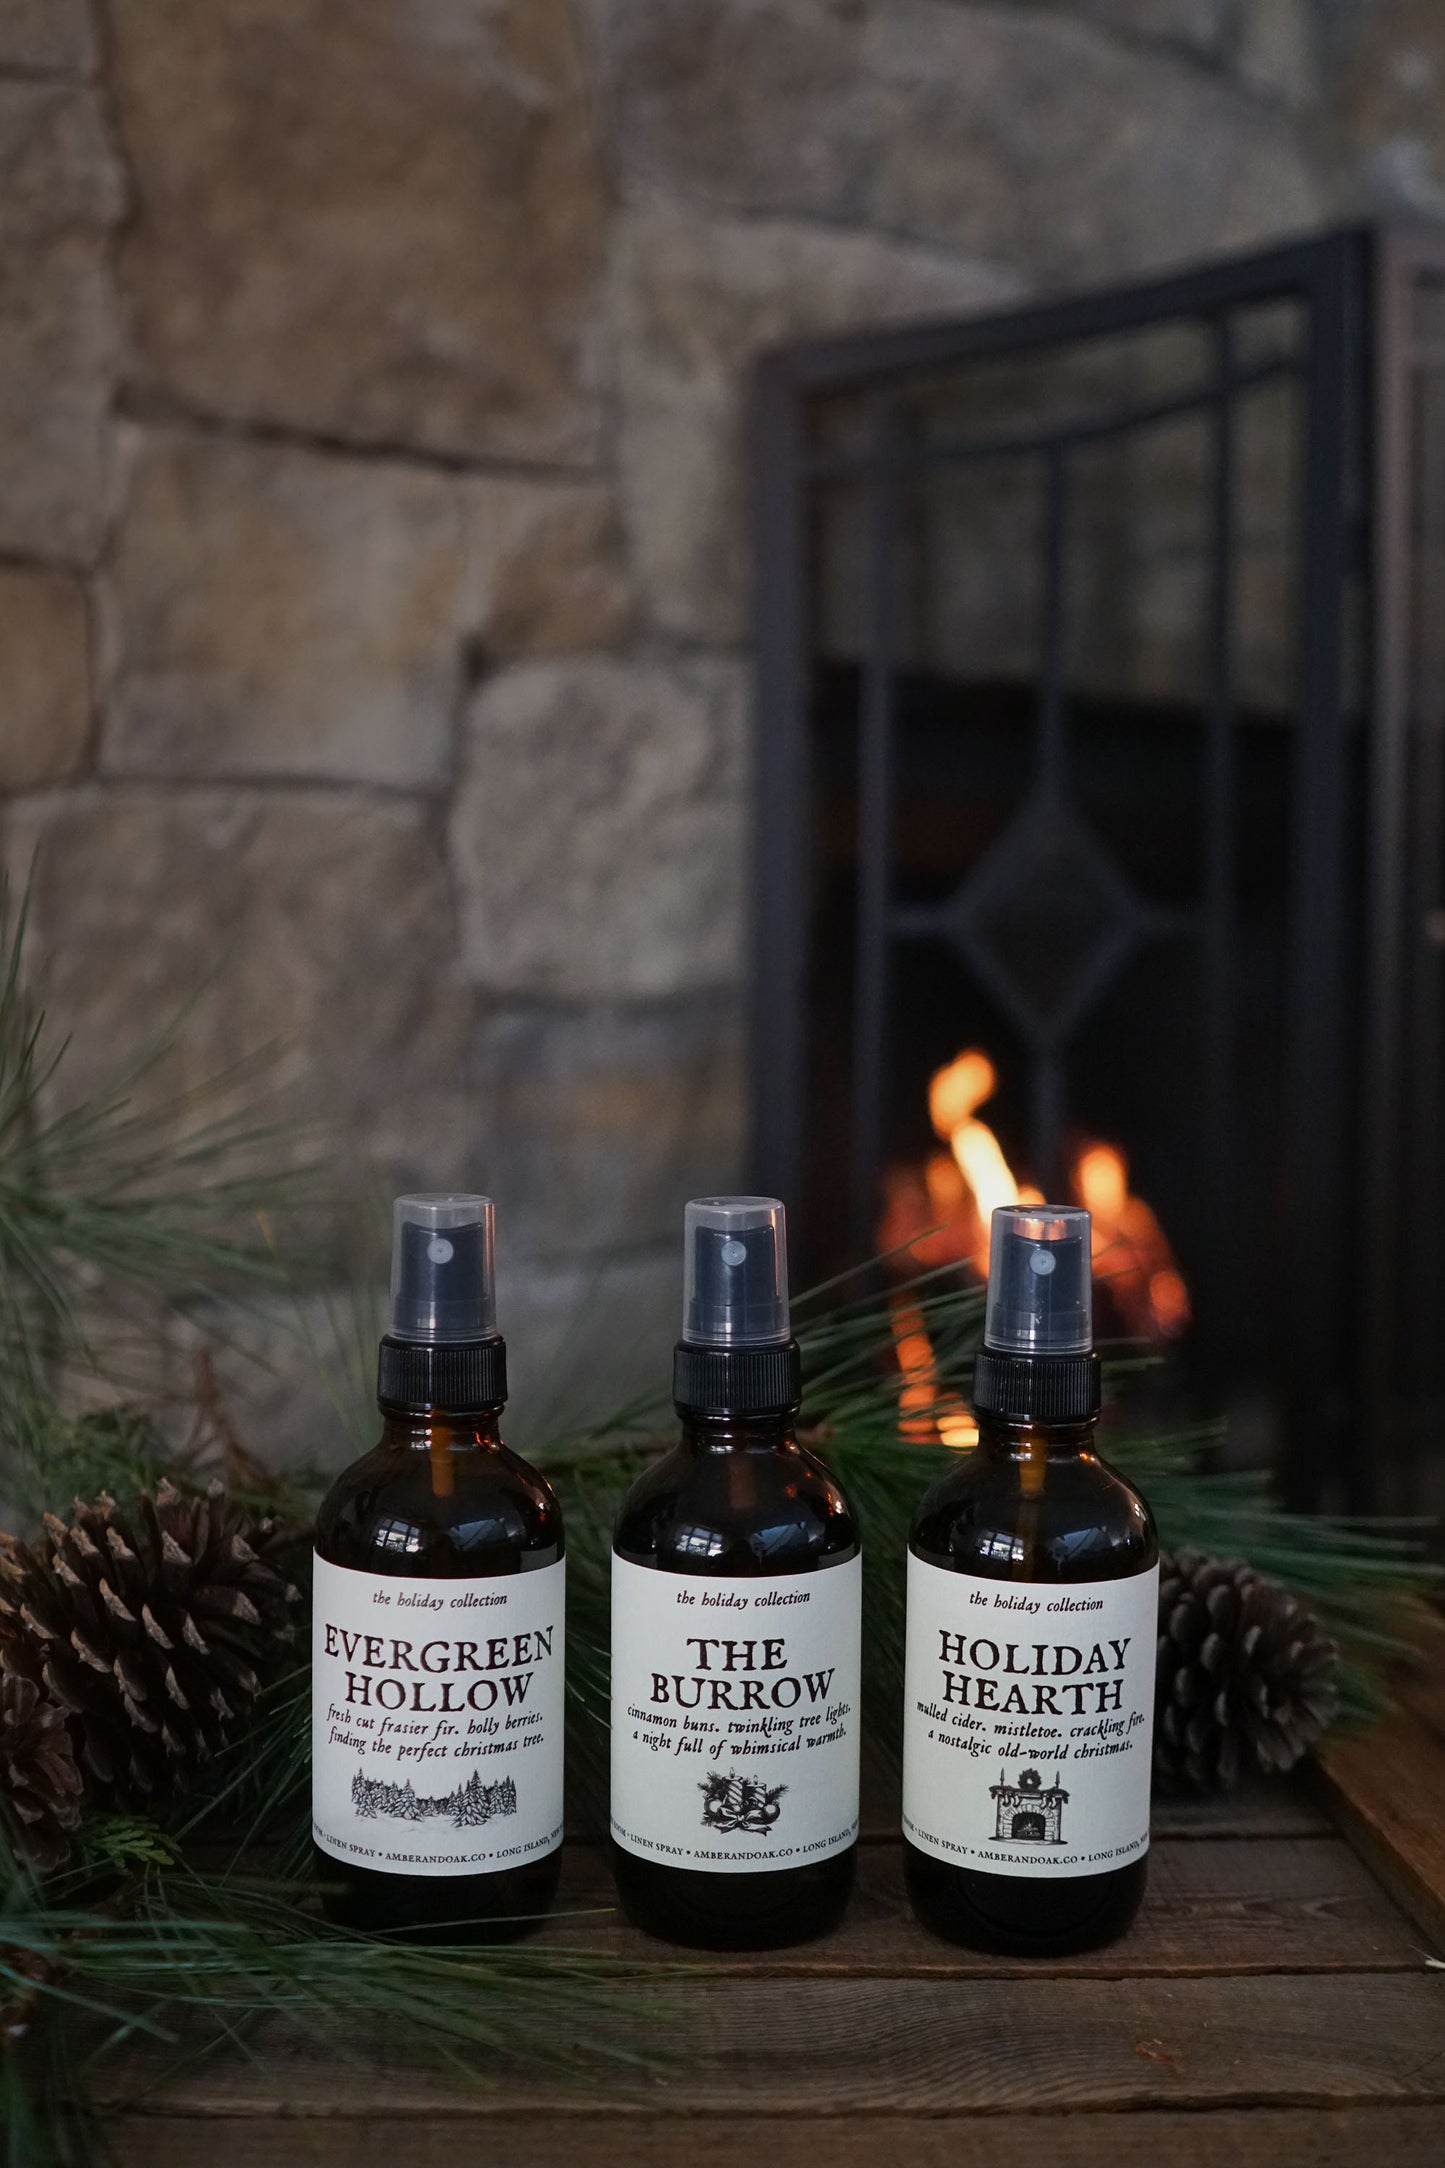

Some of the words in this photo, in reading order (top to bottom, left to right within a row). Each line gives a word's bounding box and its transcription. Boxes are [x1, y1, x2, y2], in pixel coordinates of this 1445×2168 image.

[373, 1590, 390, 1605] the
[397, 1592, 444, 1611] holiday
[450, 1592, 507, 1608] collection
[677, 1590, 695, 1605] the
[701, 1592, 748, 1610] holiday
[755, 1590, 811, 1607] collection
[969, 1591, 988, 1606] the
[994, 1594, 1041, 1614] holiday
[1047, 1597, 1104, 1612] collection
[324, 1623, 553, 1673] EVERGREEN
[686, 1638, 788, 1671] THE
[939, 1629, 1132, 1676] HOLIDAY
[345, 1671, 533, 1712] HOLLOW
[650, 1668, 835, 1710] BURROW
[942, 1670, 1124, 1715] HEARTH
[326, 1703, 351, 1723] fresh
[356, 1716, 375, 1729] cut
[377, 1717, 428, 1736] frasier
[432, 1720, 460, 1740] fir.
[467, 1719, 499, 1735] holly
[505, 1710, 543, 1730] berries.
[627, 1703, 677, 1728] cinnamon
[683, 1715, 720, 1733] buns.
[727, 1717, 794, 1738] twinkling
[800, 1714, 821, 1729] tree
[826, 1702, 851, 1724] lights.
[917, 1700, 947, 1722] mulled
[952, 1713, 987, 1731] cider.
[994, 1722, 1062, 1738] mistletoe.
[1070, 1719, 1124, 1740] crackling
[1126, 1711, 1145, 1734] fire.
[329, 1726, 366, 1755] finding
[372, 1738, 392, 1754] the
[397, 1742, 448, 1762] perfect
[454, 1740, 518, 1757] christmas
[523, 1732, 544, 1747] tree.
[632, 1730, 638, 1740] a
[643, 1731, 672, 1751] night
[674, 1737, 703, 1756] full
[709, 1739, 727, 1760] of
[731, 1735, 801, 1755] whimsical
[806, 1723, 847, 1749] warmth.
[928, 1729, 934, 1739] a
[939, 1733, 992, 1757] nostalgic
[998, 1742, 1068, 1760] old-world
[1074, 1740, 1133, 1759] christmas.
[349, 1844, 375, 1857] SPRAY
[385, 1852, 486, 1863] AMBERANDOAK.CO
[496, 1846, 521, 1858] LONG
[630, 1833, 653, 1848] LINEN
[656, 1843, 683, 1855] SPRAY
[694, 1848, 793, 1860] AMBERANDOAK.CO
[803, 1840, 826, 1852] LONG
[942, 1840, 968, 1854] SPRAY
[978, 1851, 1078, 1864] AMBERANDOAK.CO
[1088, 1850, 1113, 1861] LONG
